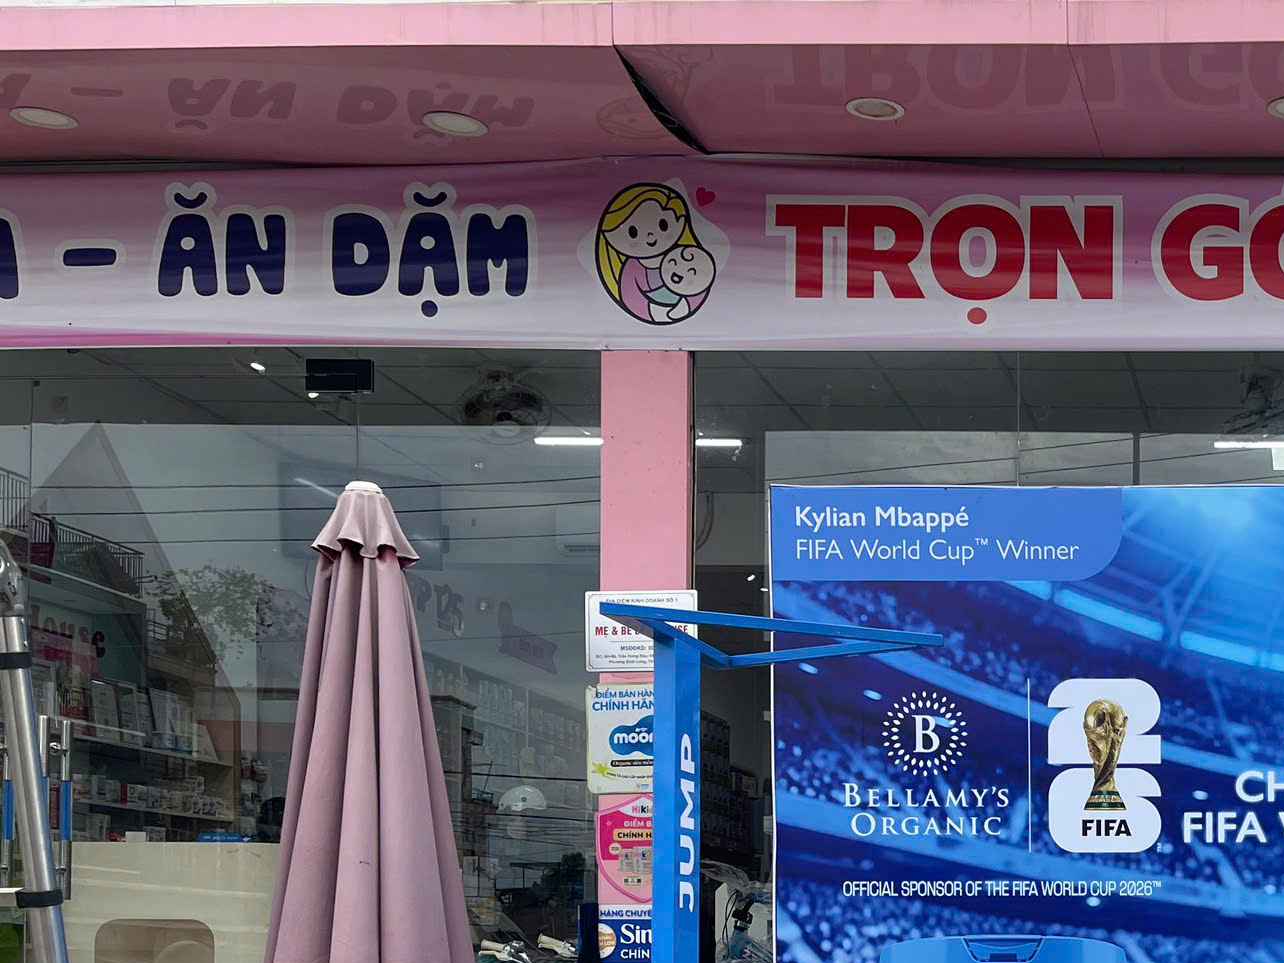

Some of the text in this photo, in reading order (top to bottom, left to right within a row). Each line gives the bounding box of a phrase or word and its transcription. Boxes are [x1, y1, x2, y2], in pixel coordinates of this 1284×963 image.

[158, 190, 286, 297] ĂN
[332, 190, 527, 318] DẶM
[775, 204, 1115, 324] TRỌN
[795, 506, 969, 533] Kylian Mbappé
[796, 541, 843, 560] FIFA
[850, 540, 920, 560] World
[996, 540, 1079, 560] Winner
[612, 627, 618, 635] &
[618, 689, 636, 698] BÁN
[592, 699, 629, 711] CHÍNH
[912, 715, 940, 754] B
[679, 733, 695, 912] JUMP
[851, 813, 1001, 837] ORGANIC
[1082, 819, 1132, 837] FIFA
[1183, 813, 1266, 843] FIFA
[617, 831, 643, 839] CHÍNH
[842, 880, 899, 897] OFFICIAL
[901, 880, 962, 897] SPONSOR
[965, 880, 983, 897] OF
[985, 880, 1010, 897] THE
[1012, 880, 1038, 897] FIFA
[1040, 880, 1087, 897] WORLD
[1090, 880, 1116, 897] CUP
